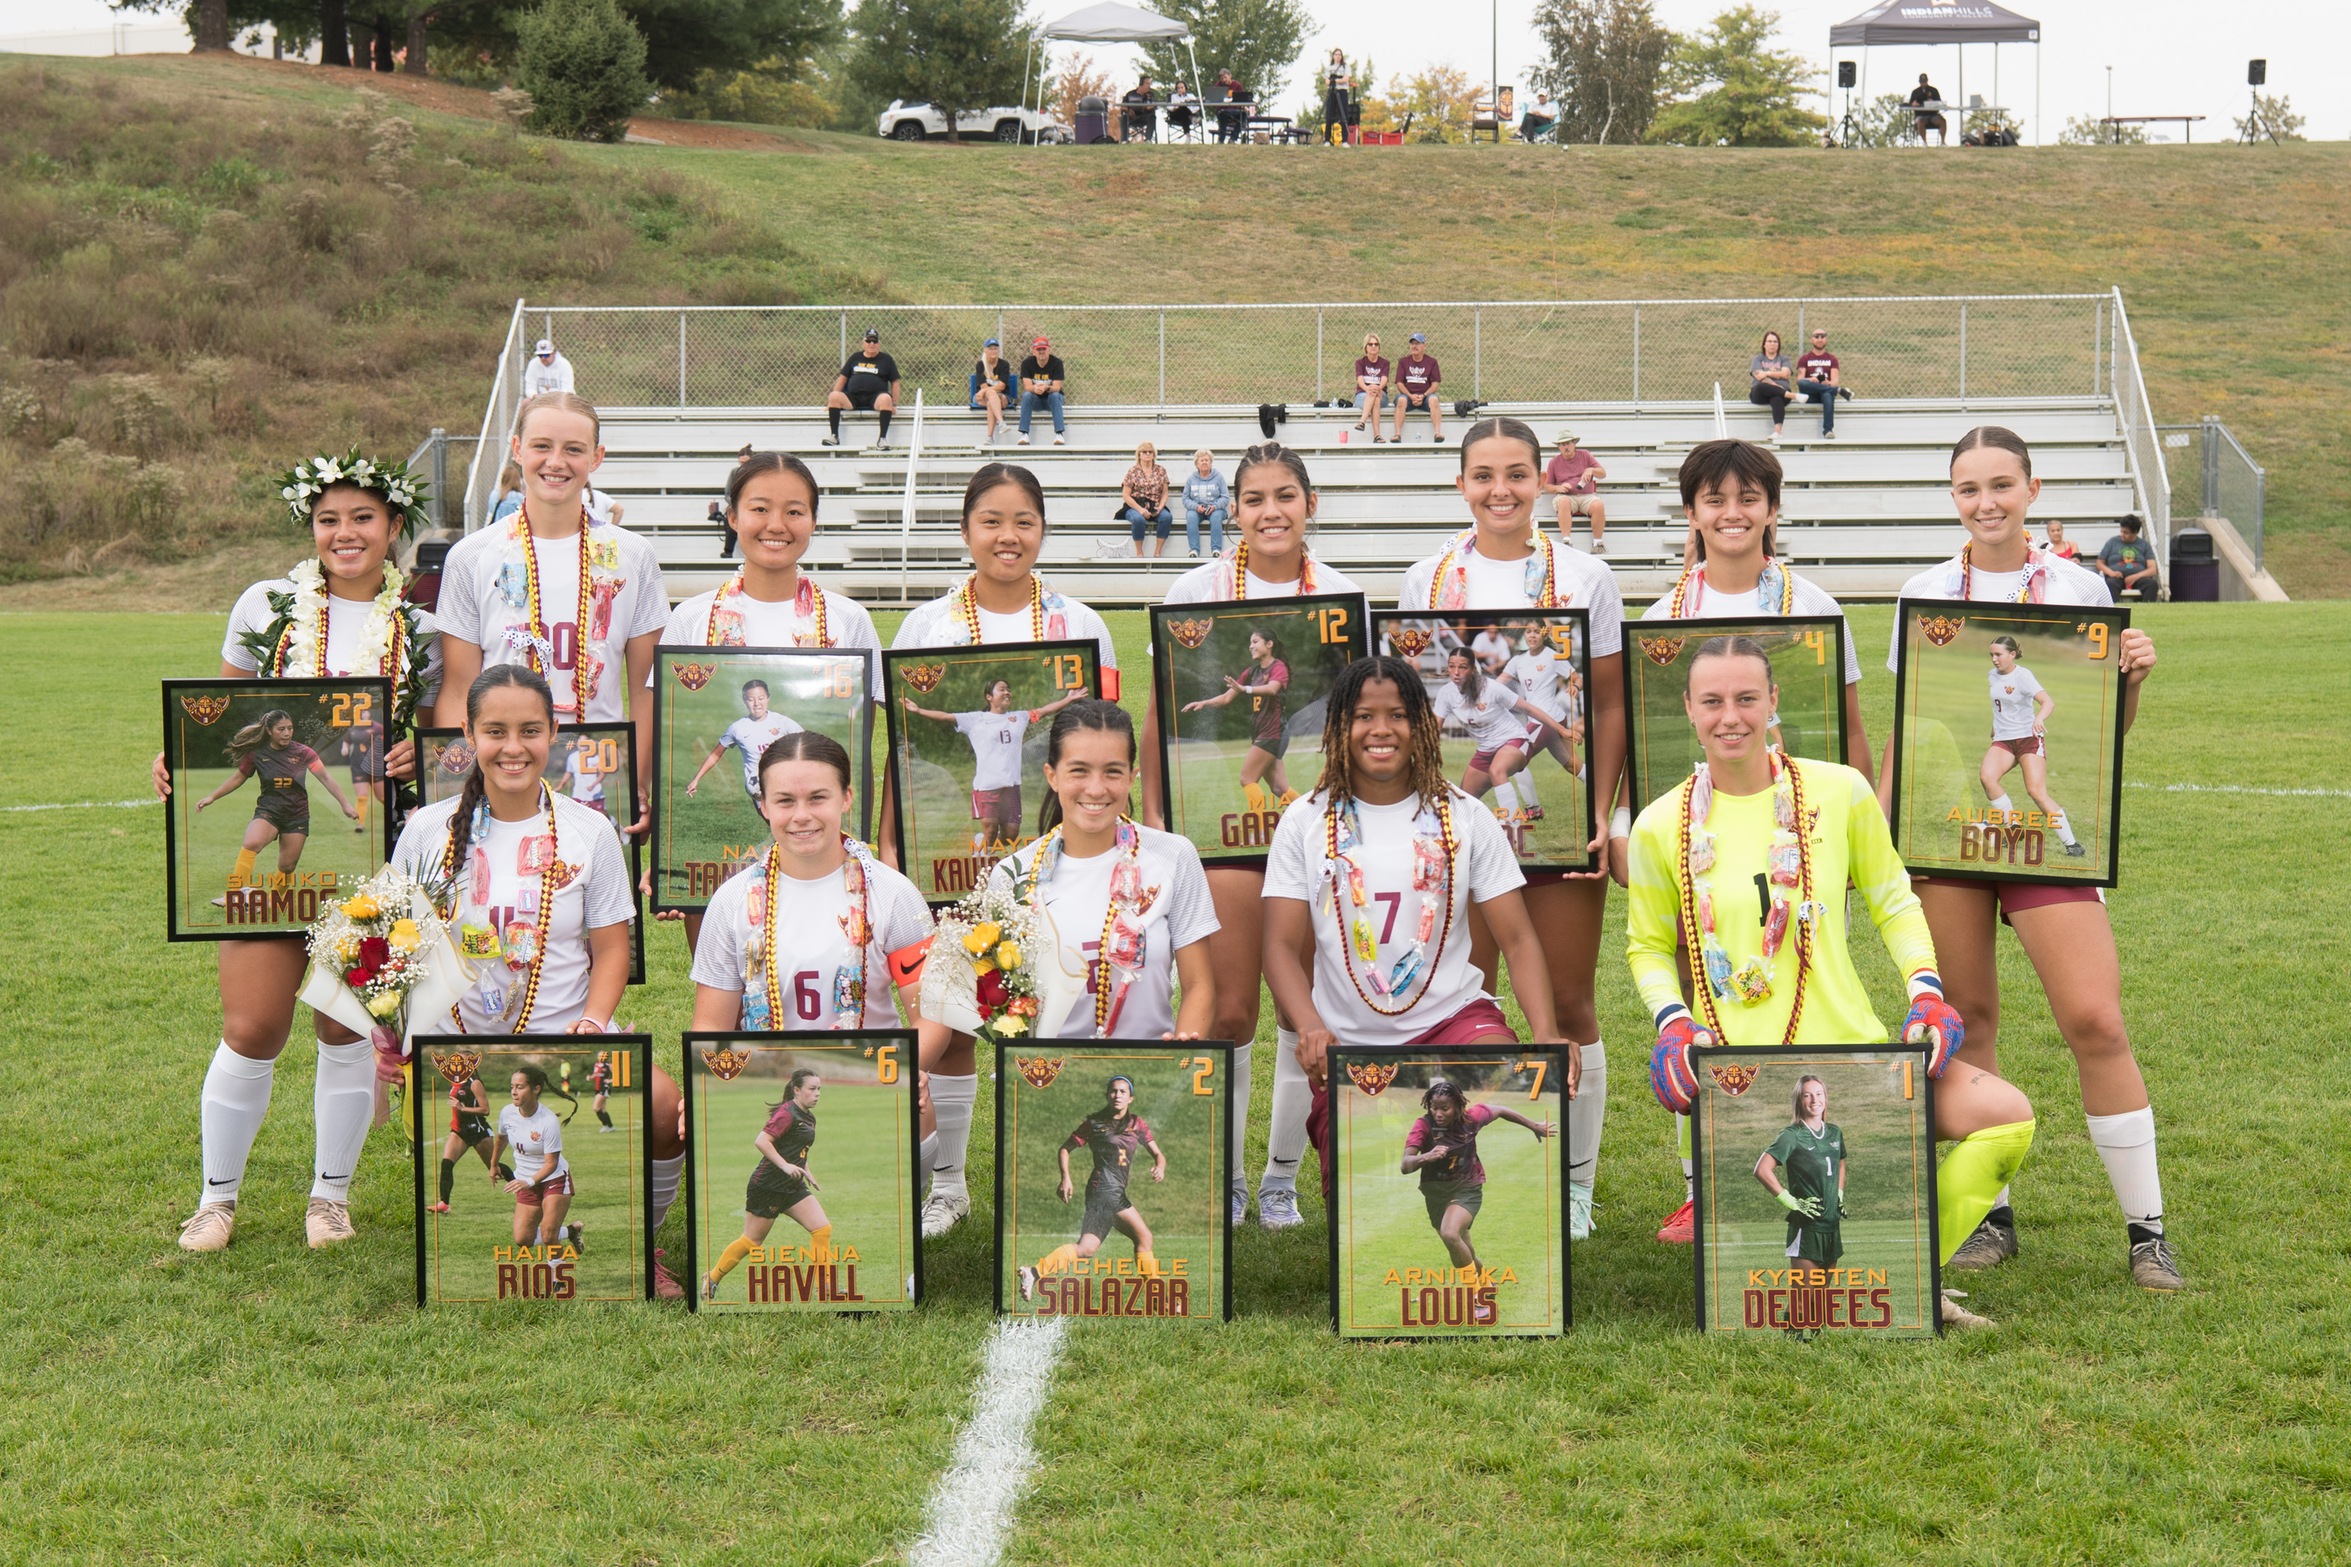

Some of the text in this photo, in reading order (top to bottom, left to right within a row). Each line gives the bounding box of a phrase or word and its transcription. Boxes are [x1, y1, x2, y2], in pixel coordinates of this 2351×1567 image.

[1307, 608, 1349, 644] #12
[1540, 625, 1571, 660] #5
[2077, 622, 2109, 660] #9
[1792, 631, 1825, 666] #4
[812, 663, 853, 698] #16
[1042, 654, 1084, 690] #13
[319, 693, 372, 727] #22
[1994, 699, 2002, 712] 9
[1000, 730, 1011, 744] 13
[565, 738, 618, 774] #20
[1221, 811, 1285, 848] GAR
[1946, 806, 2063, 829] AUBREE
[1959, 825, 2045, 866] BOYD
[227, 871, 337, 888] SUMIKO
[1374, 891, 1401, 944] 7
[794, 970, 821, 1021] 6
[599, 1051, 631, 1087] #11
[863, 1046, 898, 1084] #6
[1179, 1057, 1214, 1096] #2
[1513, 1061, 1547, 1100] #7
[1890, 1060, 1913, 1100] #1
[1826, 1156, 1832, 1176] 1
[493, 1244, 580, 1262] HAIFA
[749, 1245, 861, 1263] SIENNA
[1038, 1257, 1189, 1276] MICHELLE
[497, 1262, 576, 1300] RIOS
[747, 1263, 865, 1304] HAVILL
[1748, 1268, 1888, 1287] KYRSTEN
[1036, 1276, 1190, 1318] SALAZAR
[1401, 1286, 1499, 1328] LOUIS
[1743, 1288, 1893, 1330] DEWEES
